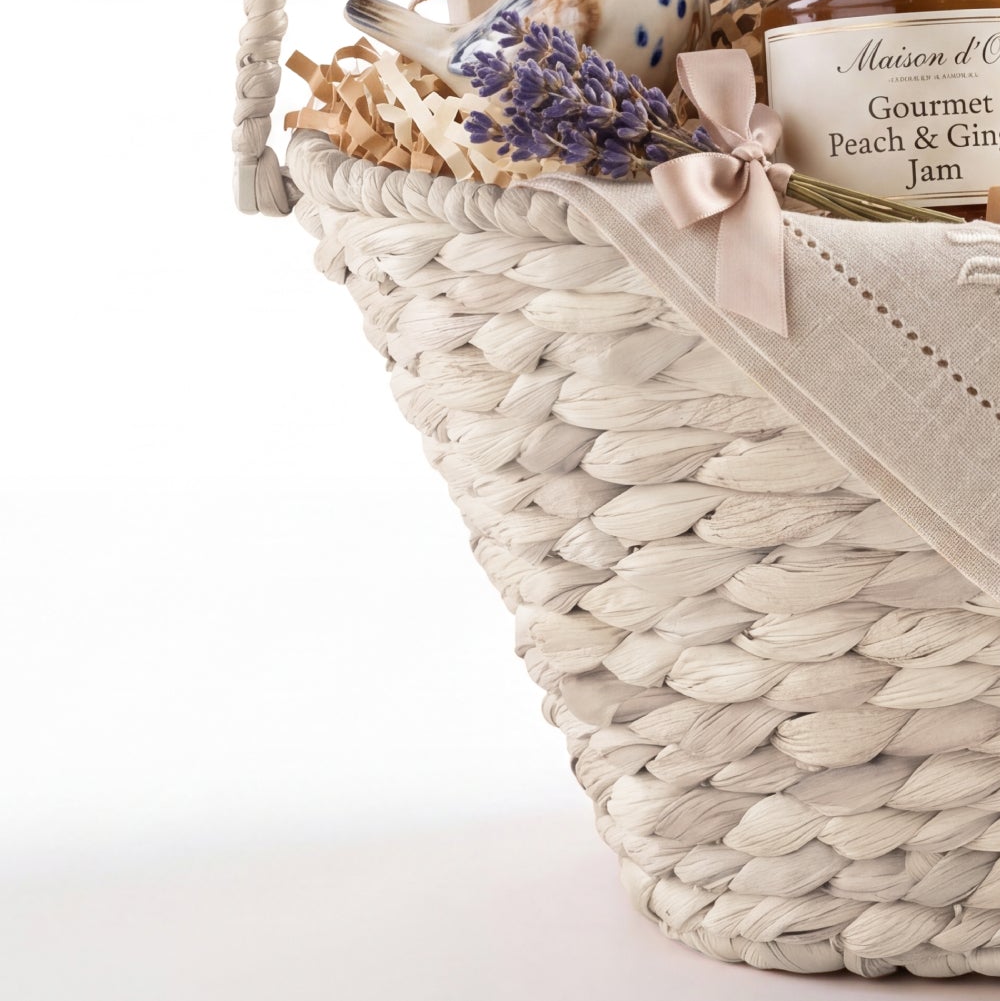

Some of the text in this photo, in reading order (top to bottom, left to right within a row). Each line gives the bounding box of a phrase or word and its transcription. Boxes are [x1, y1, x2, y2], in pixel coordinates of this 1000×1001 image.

[837, 38, 947, 73] Maison
[868, 95, 994, 120] Gourmet
[828, 127, 906, 157] Peach
[914, 126, 939, 150] &
[905, 158, 963, 190] Jam
